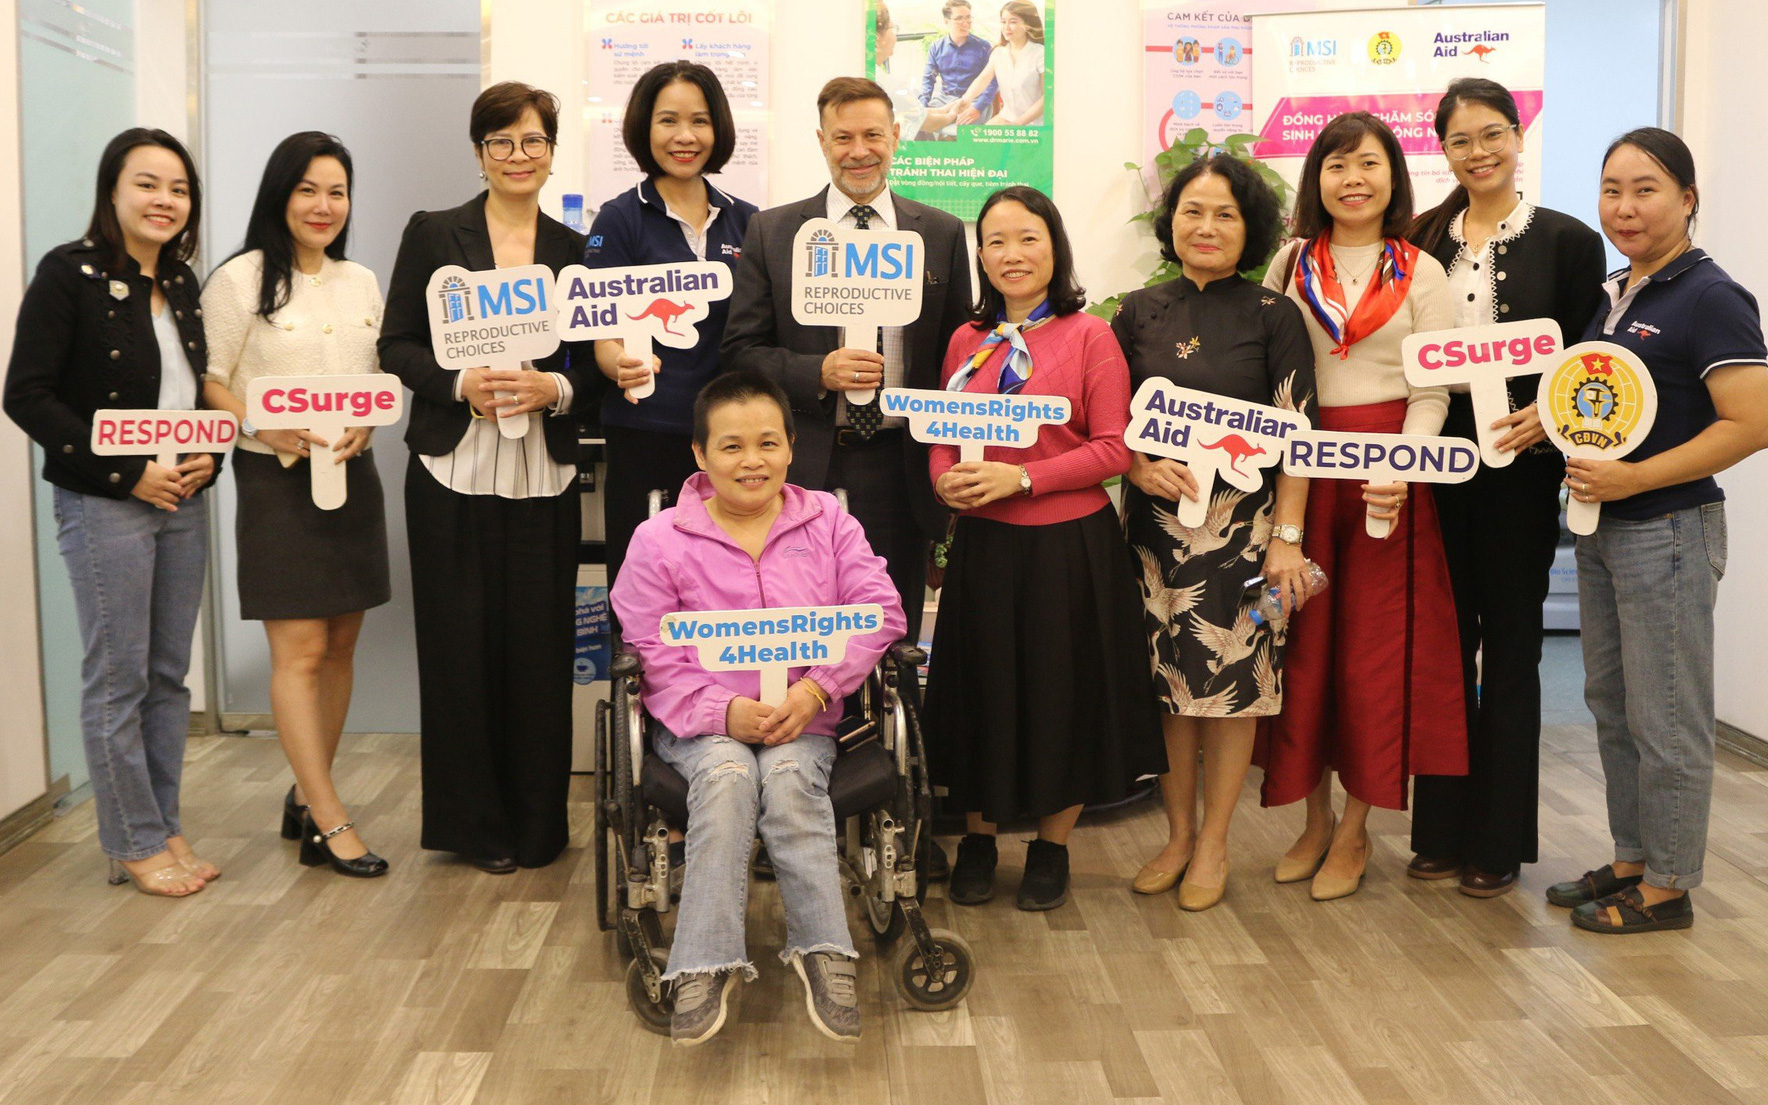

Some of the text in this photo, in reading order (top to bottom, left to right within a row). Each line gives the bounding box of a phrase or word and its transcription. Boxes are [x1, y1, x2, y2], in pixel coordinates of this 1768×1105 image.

[605, 11, 636, 24] CÁC
[640, 11, 664, 24] GIÁ
[669, 12, 690, 26] TRỊ
[1167, 12, 1191, 21] CAM
[1194, 9, 1214, 22] KẾT
[1217, 11, 1240, 22] CỦA
[1306, 40, 1337, 56] MSI
[1433, 30, 1509, 44] Australian
[1433, 46, 1458, 58] Aid
[983, 129, 1002, 137] 1900
[1005, 129, 1014, 137] 55
[1016, 129, 1026, 137] 88
[1282, 130, 1315, 141] SINH
[890, 155, 974, 168] CÁC BIỆN PHÁP
[890, 166, 1008, 180] TRÁNH THAI HIỆN ĐẠI
[845, 243, 913, 280] MSI
[567, 269, 719, 300] Australian
[804, 286, 912, 301] REPRODUCTIVE
[477, 277, 547, 319] MSI
[804, 302, 864, 315] CHOICES
[569, 302, 618, 329] Aid
[444, 320, 550, 345] REPRODUCTIVE
[1631, 320, 1661, 335] Australian
[446, 340, 506, 359] CHOICES
[1417, 334, 1556, 371] CSurge
[262, 388, 396, 418] CSurge
[885, 394, 1066, 422] WomensRights
[98, 418, 236, 446] RESPOND
[926, 421, 1020, 443] 4Health
[1139, 417, 1192, 448] Aid
[1290, 440, 1476, 474] RESPOND
[668, 611, 878, 640] WomensRights
[719, 640, 828, 665] 4Health
